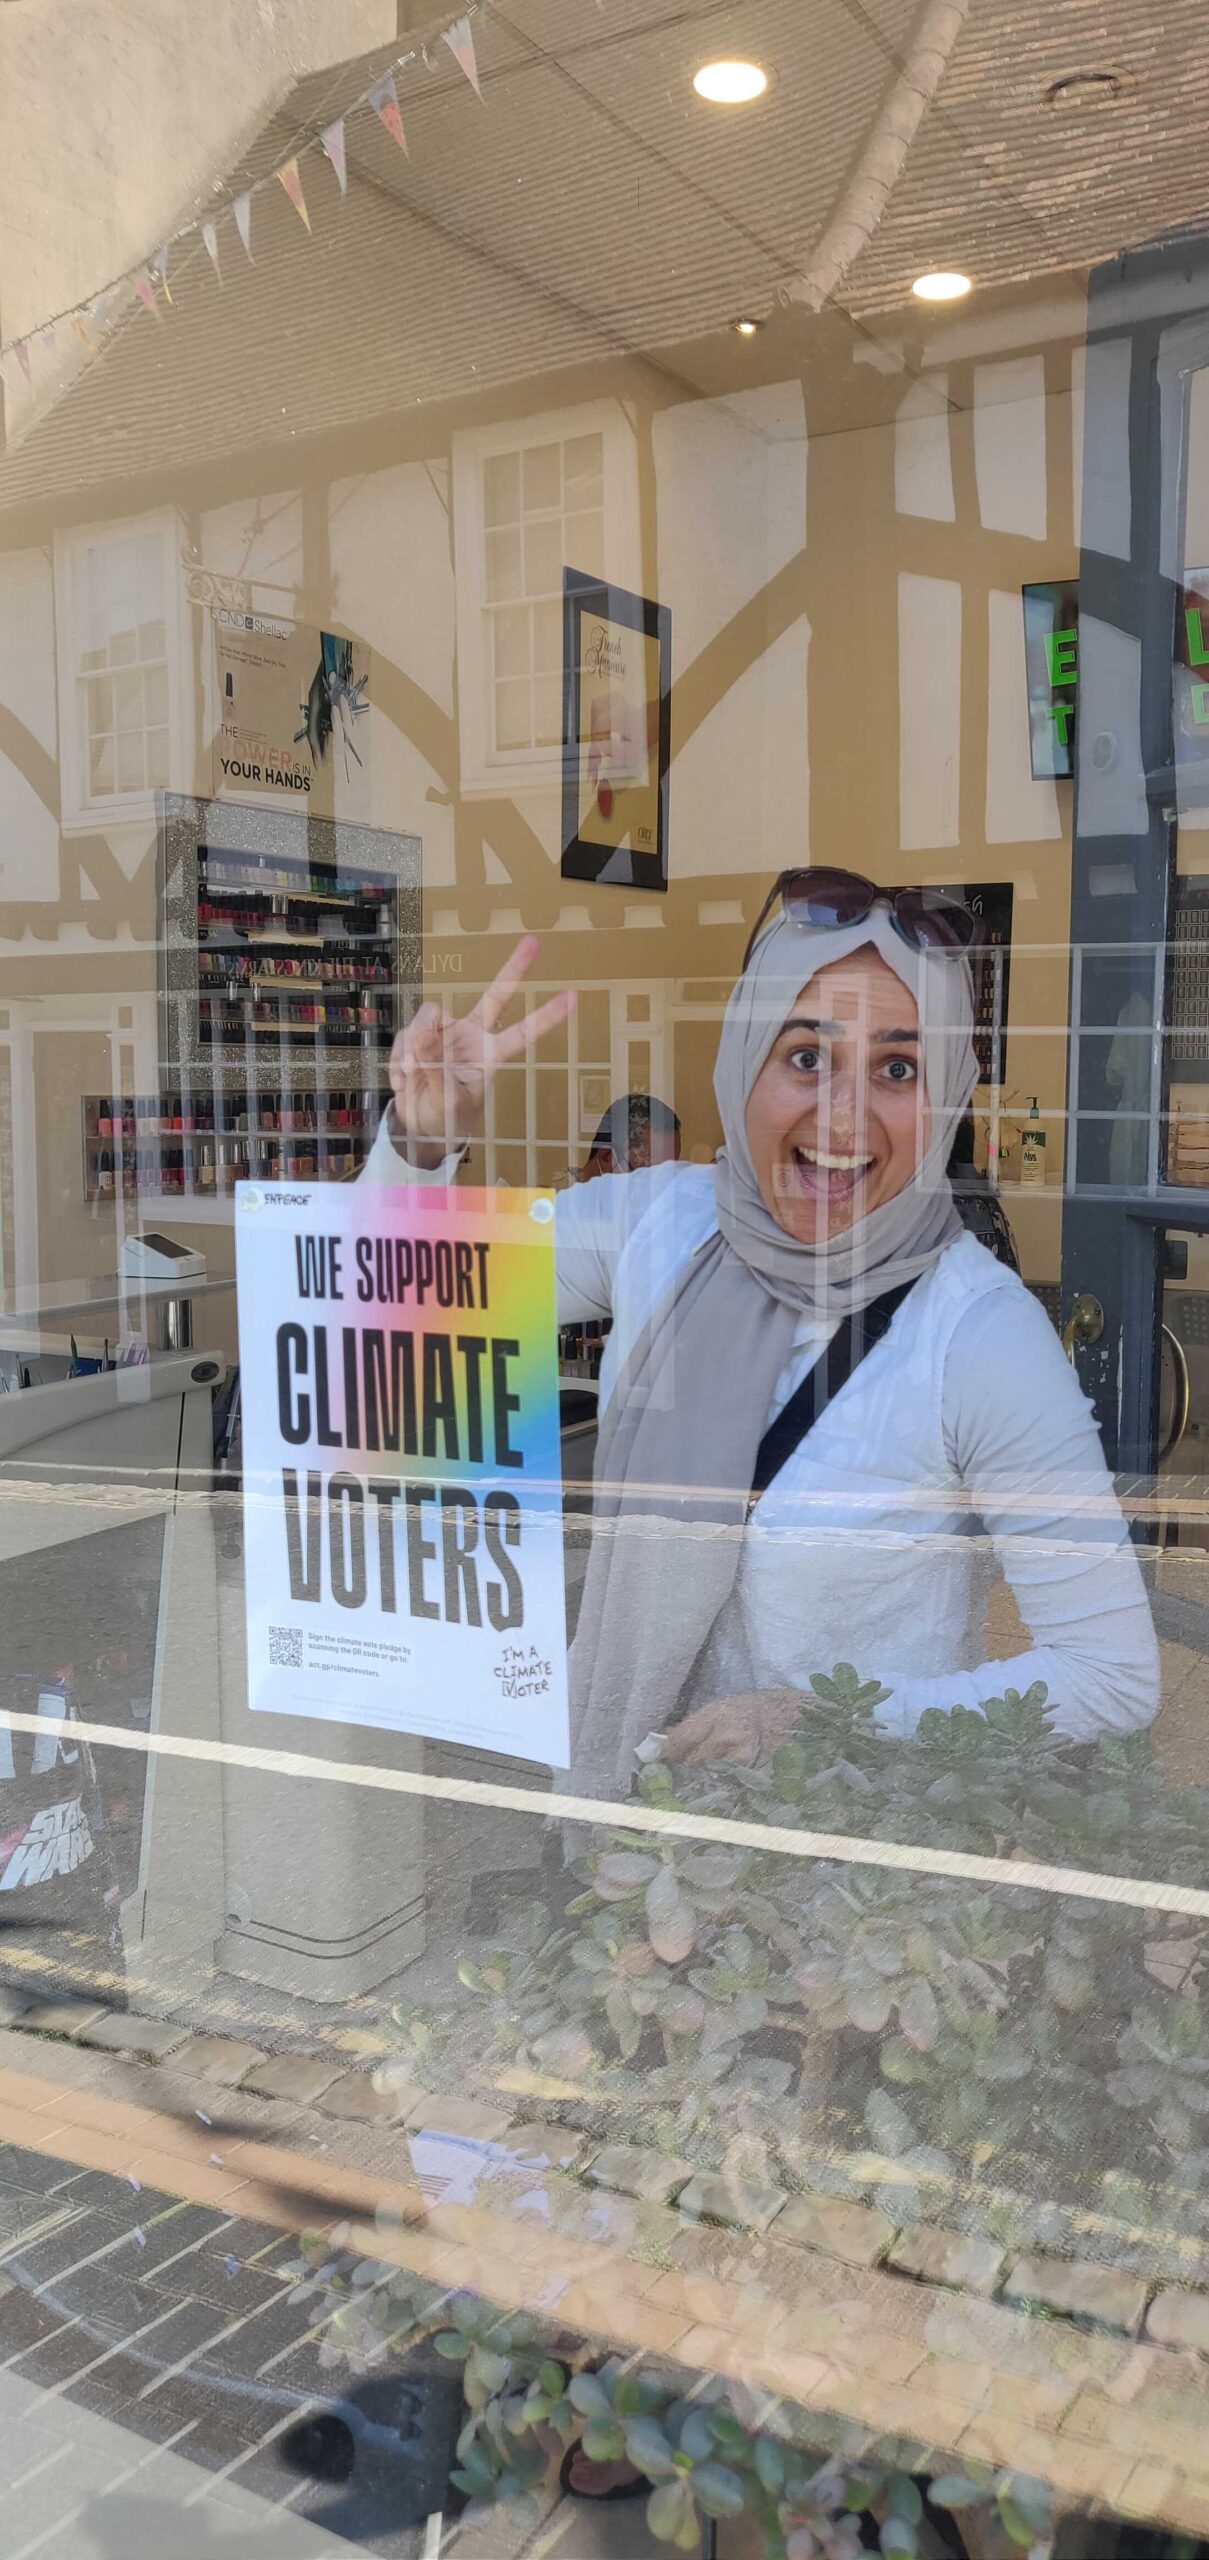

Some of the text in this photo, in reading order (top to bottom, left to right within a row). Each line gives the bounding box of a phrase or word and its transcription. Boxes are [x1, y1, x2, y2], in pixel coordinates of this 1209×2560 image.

[219, 608, 288, 640] CND Shellac
[220, 724, 238, 738] THE
[221, 758, 311, 792] YOUR HANDS
[293, 763, 300, 774] IS
[303, 764, 311, 777] IN
[294, 1234, 491, 1310] WE SUPPORT
[276, 1322, 524, 1468] CLIMATE
[281, 1468, 525, 1632] VOTERS
[308, 1632, 411, 1656] Sign the climate vote pledge by
[308, 1643, 339, 1654] scanning
[340, 1646, 352, 1655] the
[352, 1647, 362, 1656] QR
[363, 1650, 380, 1659] code
[502, 1645, 539, 1662] I'M A
[494, 1660, 553, 1678] CLIMATE
[502, 1679, 550, 1699] VOTER
